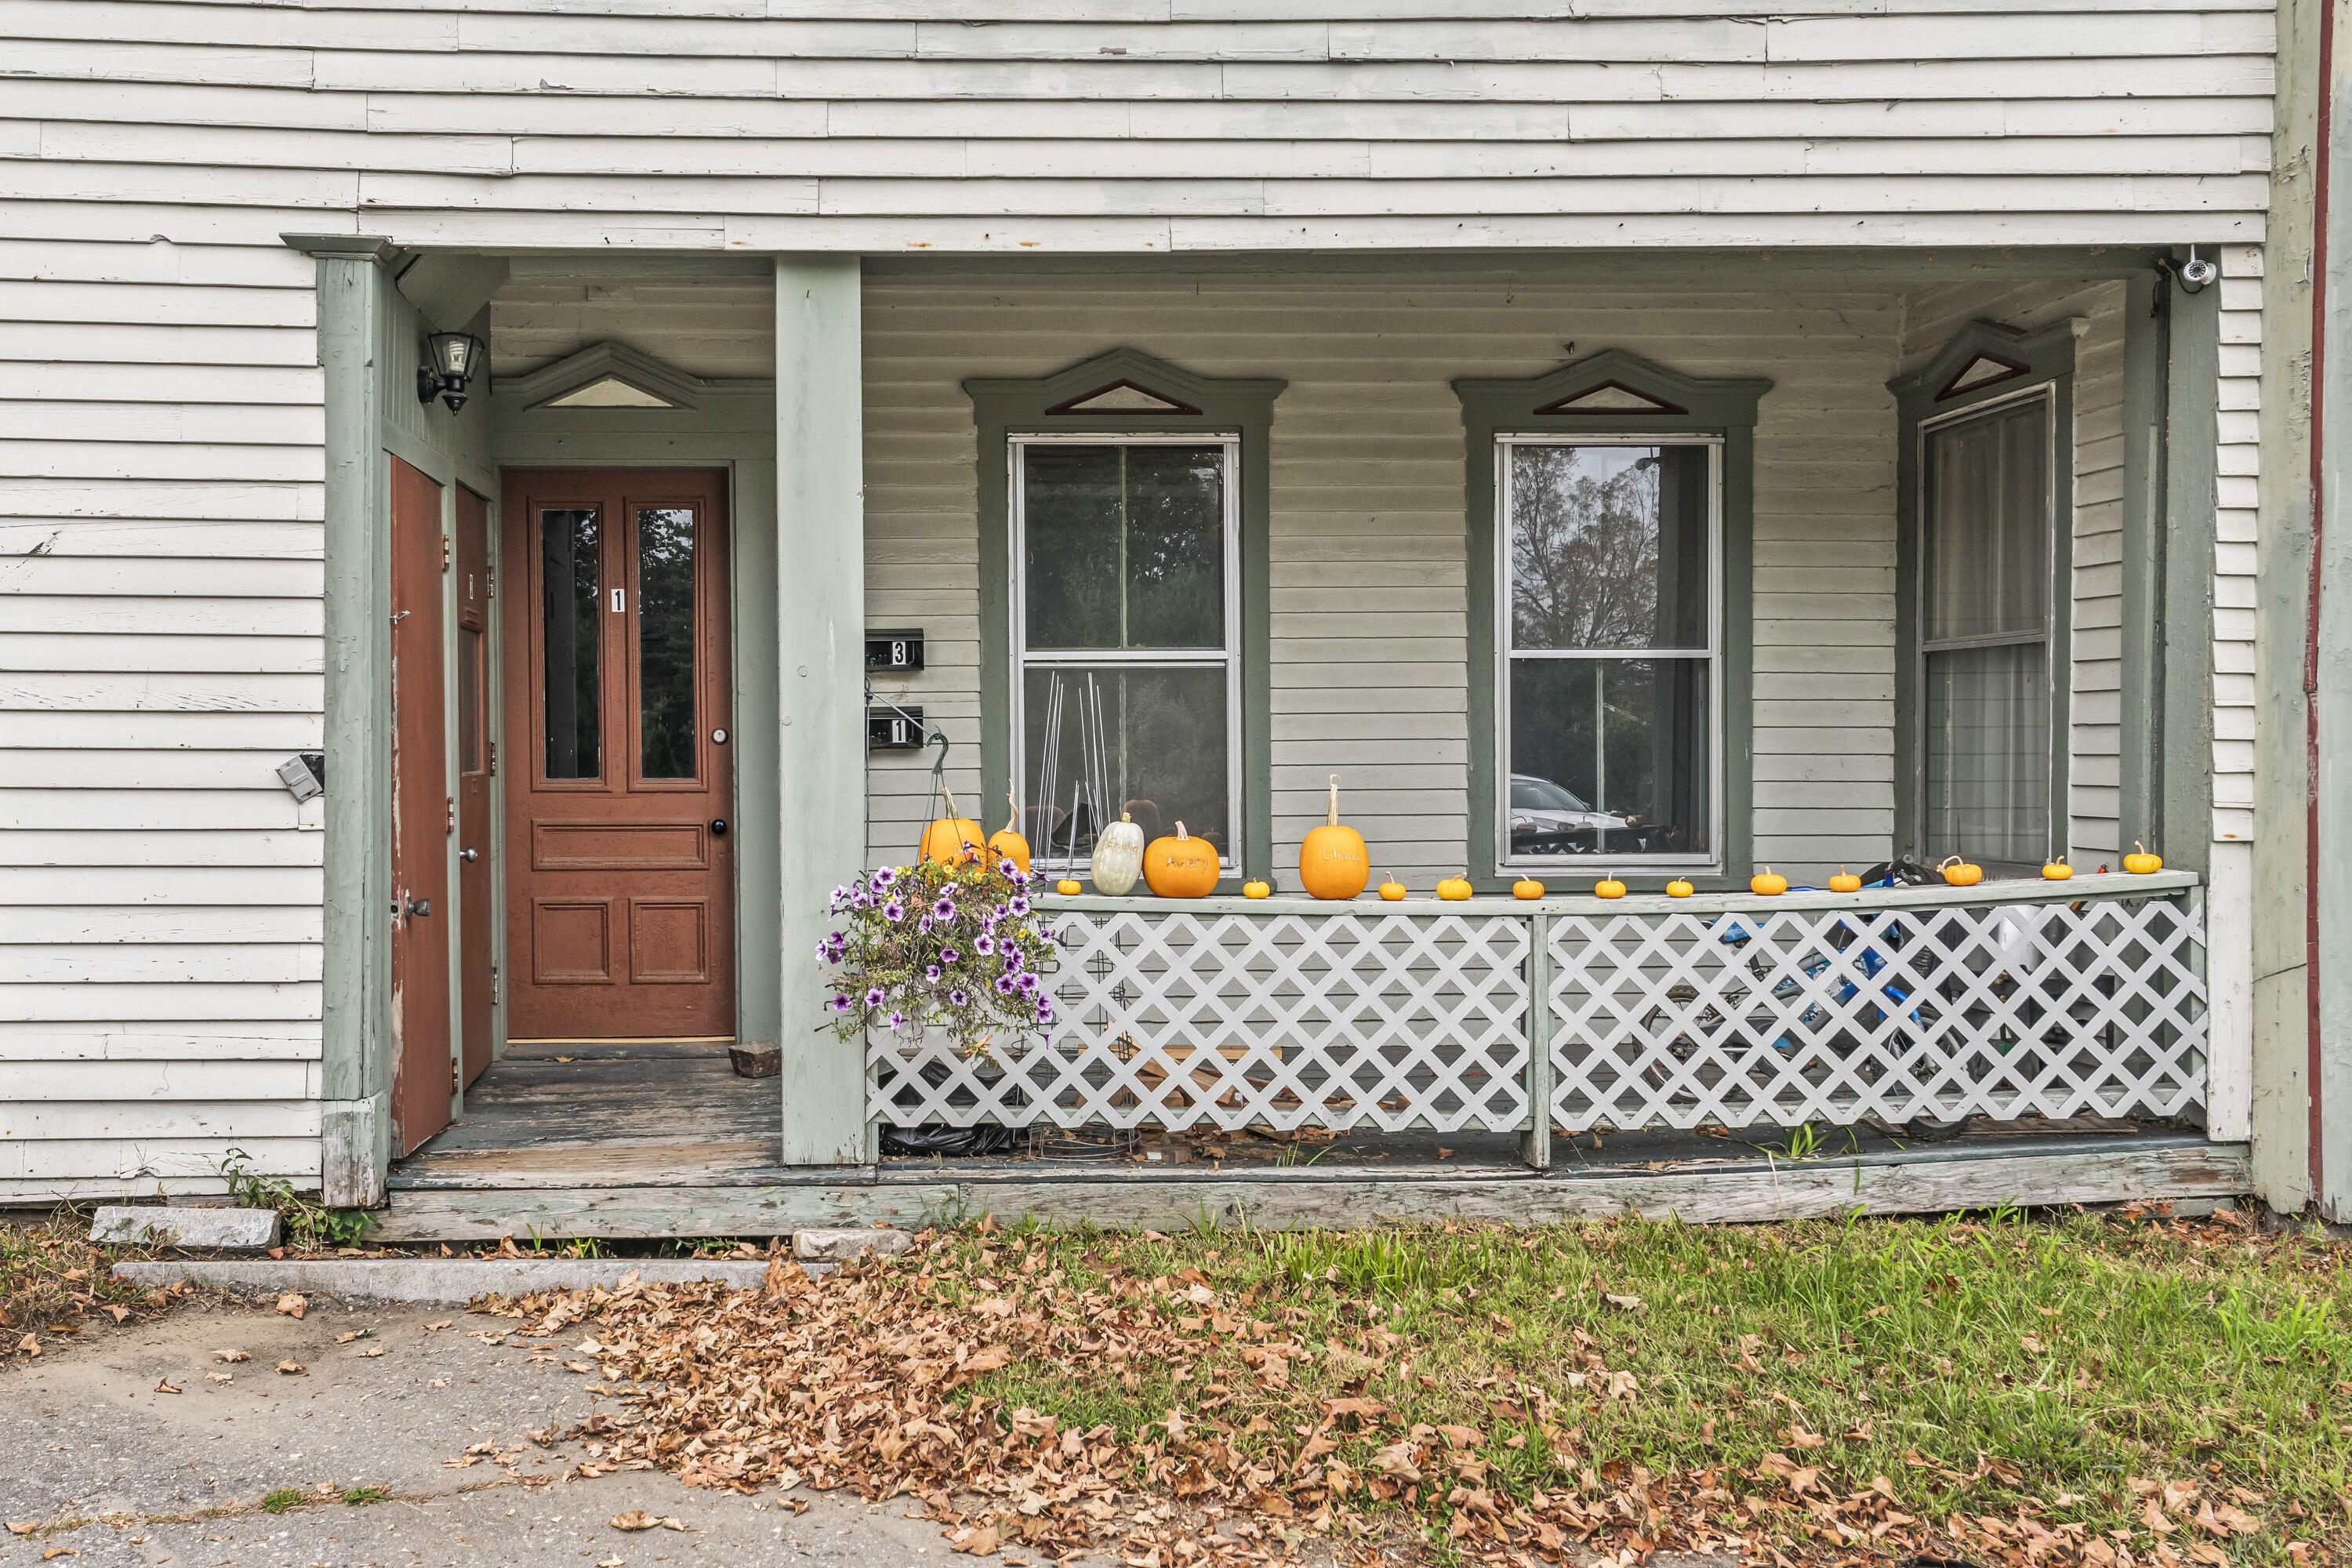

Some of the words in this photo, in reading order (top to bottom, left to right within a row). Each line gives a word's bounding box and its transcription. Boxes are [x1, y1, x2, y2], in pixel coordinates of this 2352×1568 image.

[615, 590, 621, 611] 1
[895, 641, 903, 663] 3
[895, 720, 902, 742] 1
[1166, 856, 1208, 874] Avery
